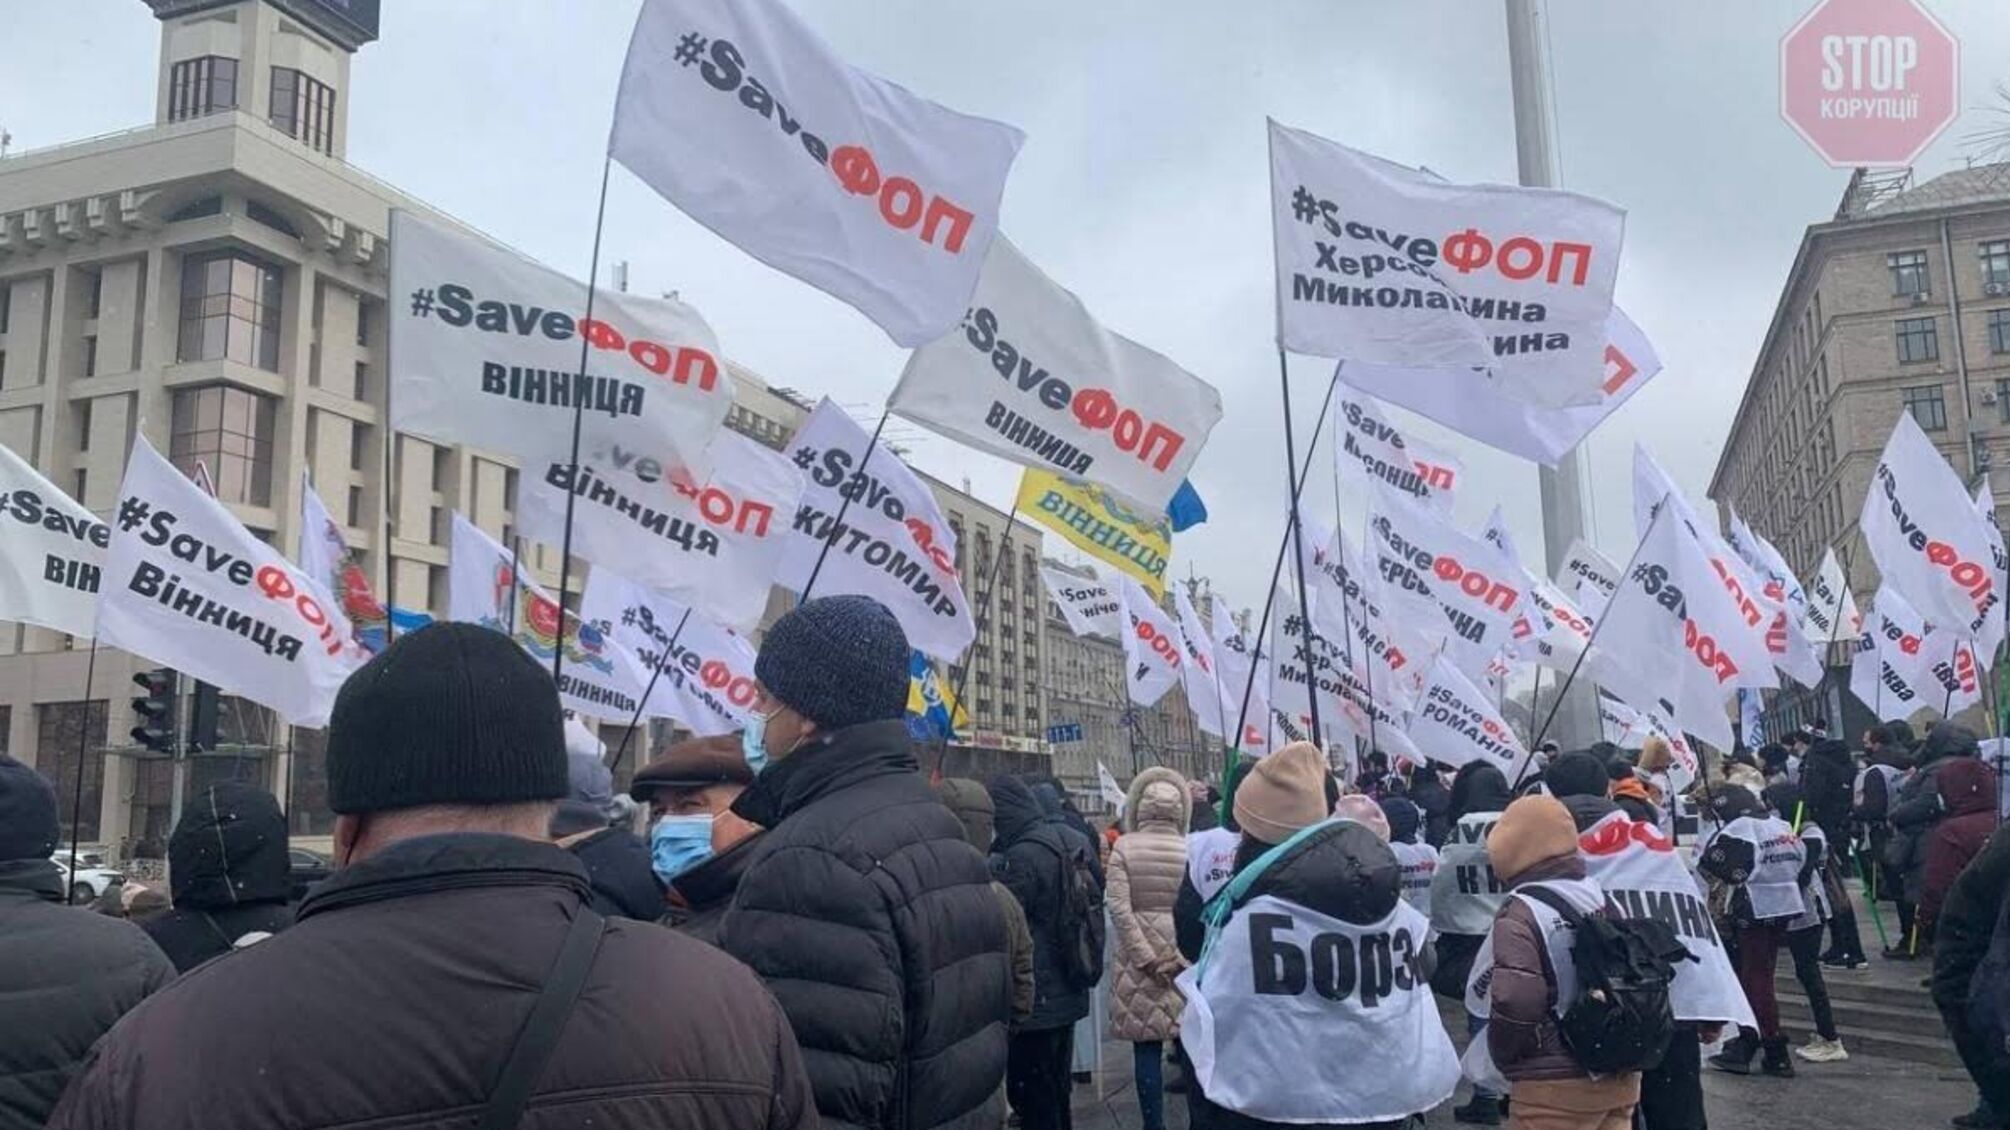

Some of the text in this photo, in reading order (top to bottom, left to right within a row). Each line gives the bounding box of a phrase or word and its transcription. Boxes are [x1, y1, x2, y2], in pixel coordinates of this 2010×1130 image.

[674, 32, 976, 254] #SaveФОП
[1291, 185, 1593, 286] #SaveФОП
[410, 283, 719, 392] #SaveФОП
[481, 361, 646, 418] ВІННИЦЯ
[984, 400, 1094, 476] ВІННИЦЯ
[1037, 489, 1168, 577] ВІННИЦЯ
[128, 560, 304, 662] Вінниця
